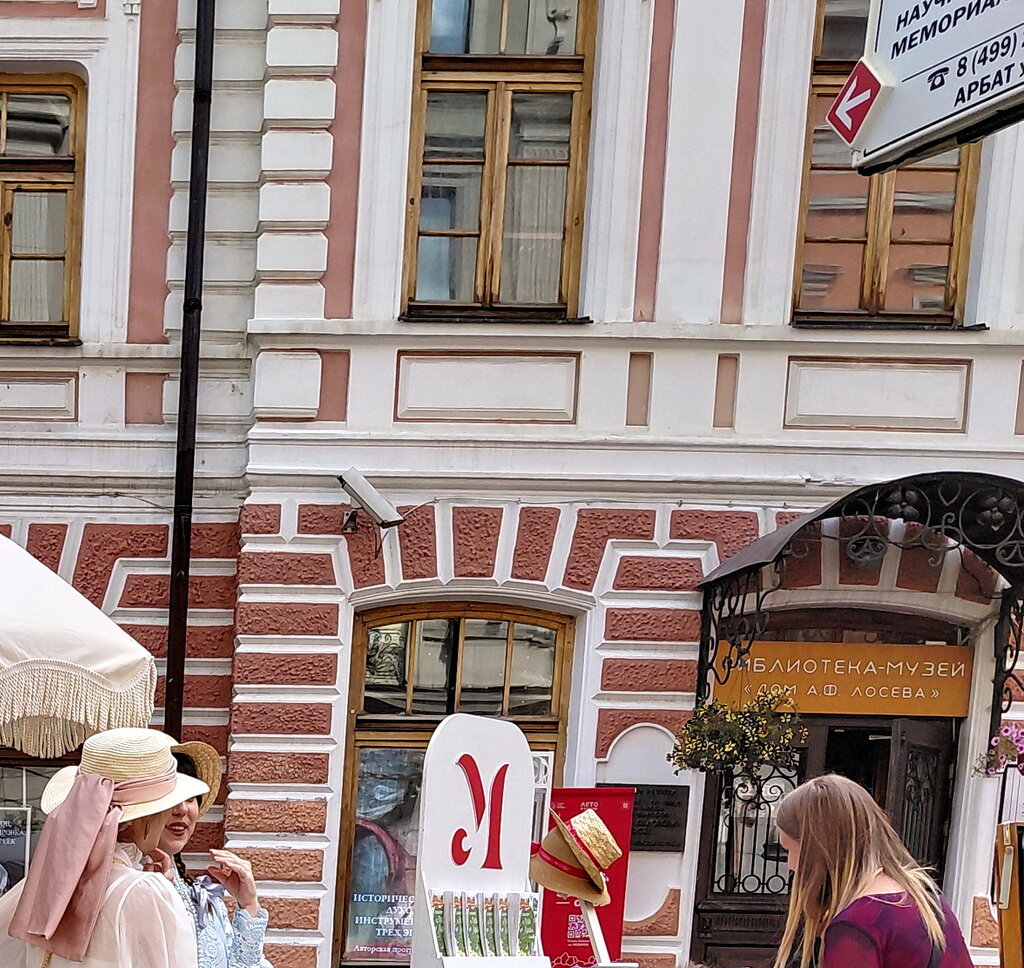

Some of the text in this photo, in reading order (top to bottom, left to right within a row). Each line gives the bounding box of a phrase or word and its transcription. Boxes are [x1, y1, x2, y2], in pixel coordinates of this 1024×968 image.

[956, 56, 968, 77] 8
[972, 32, 1017, 75] (499)
[954, 63, 1015, 107] АРБАТ
[723, 658, 965, 677] ИБЛИОТЕКА-МУЗЕЙ
[806, 684, 841, 696] А.Ф.
[376, 928, 401, 937] ТРЕХ
